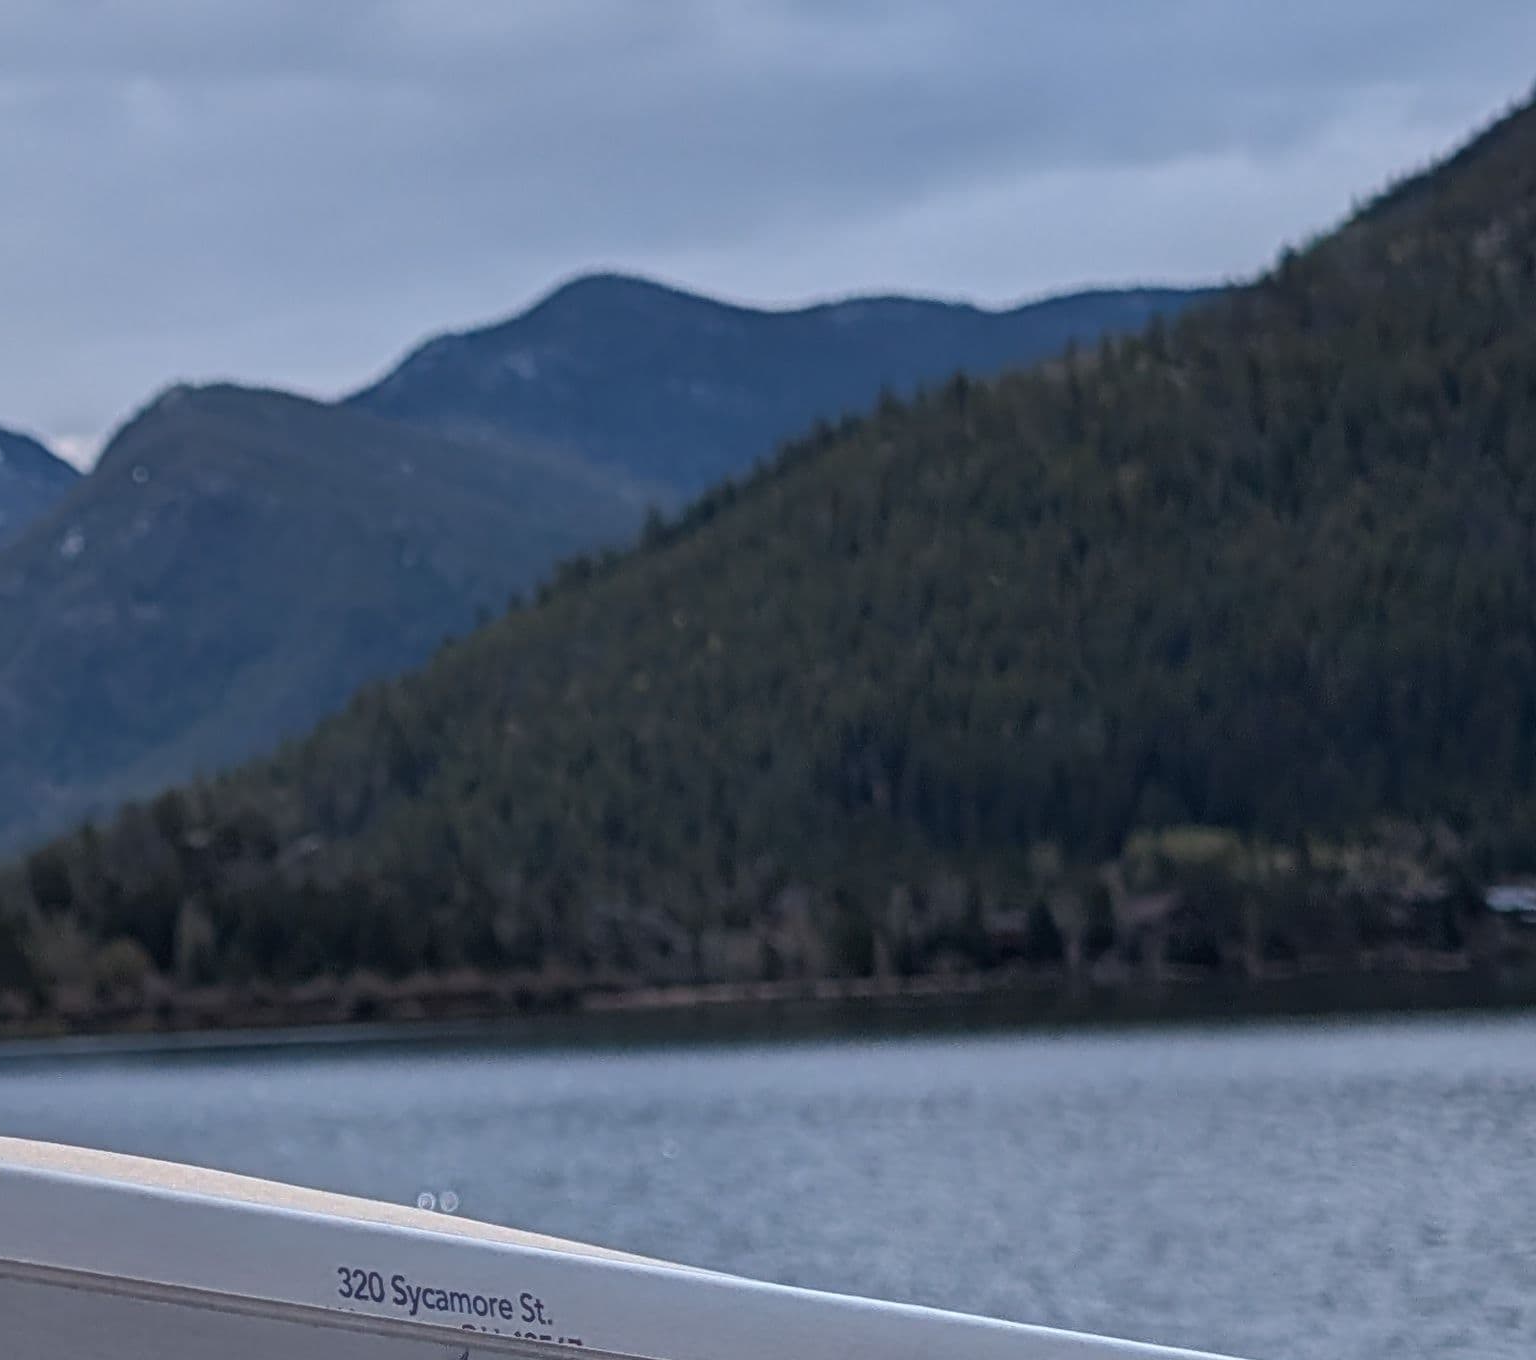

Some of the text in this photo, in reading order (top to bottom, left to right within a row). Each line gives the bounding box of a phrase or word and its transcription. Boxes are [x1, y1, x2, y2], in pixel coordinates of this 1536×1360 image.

[337, 1266, 553, 1325] 320 Sycamore St.
